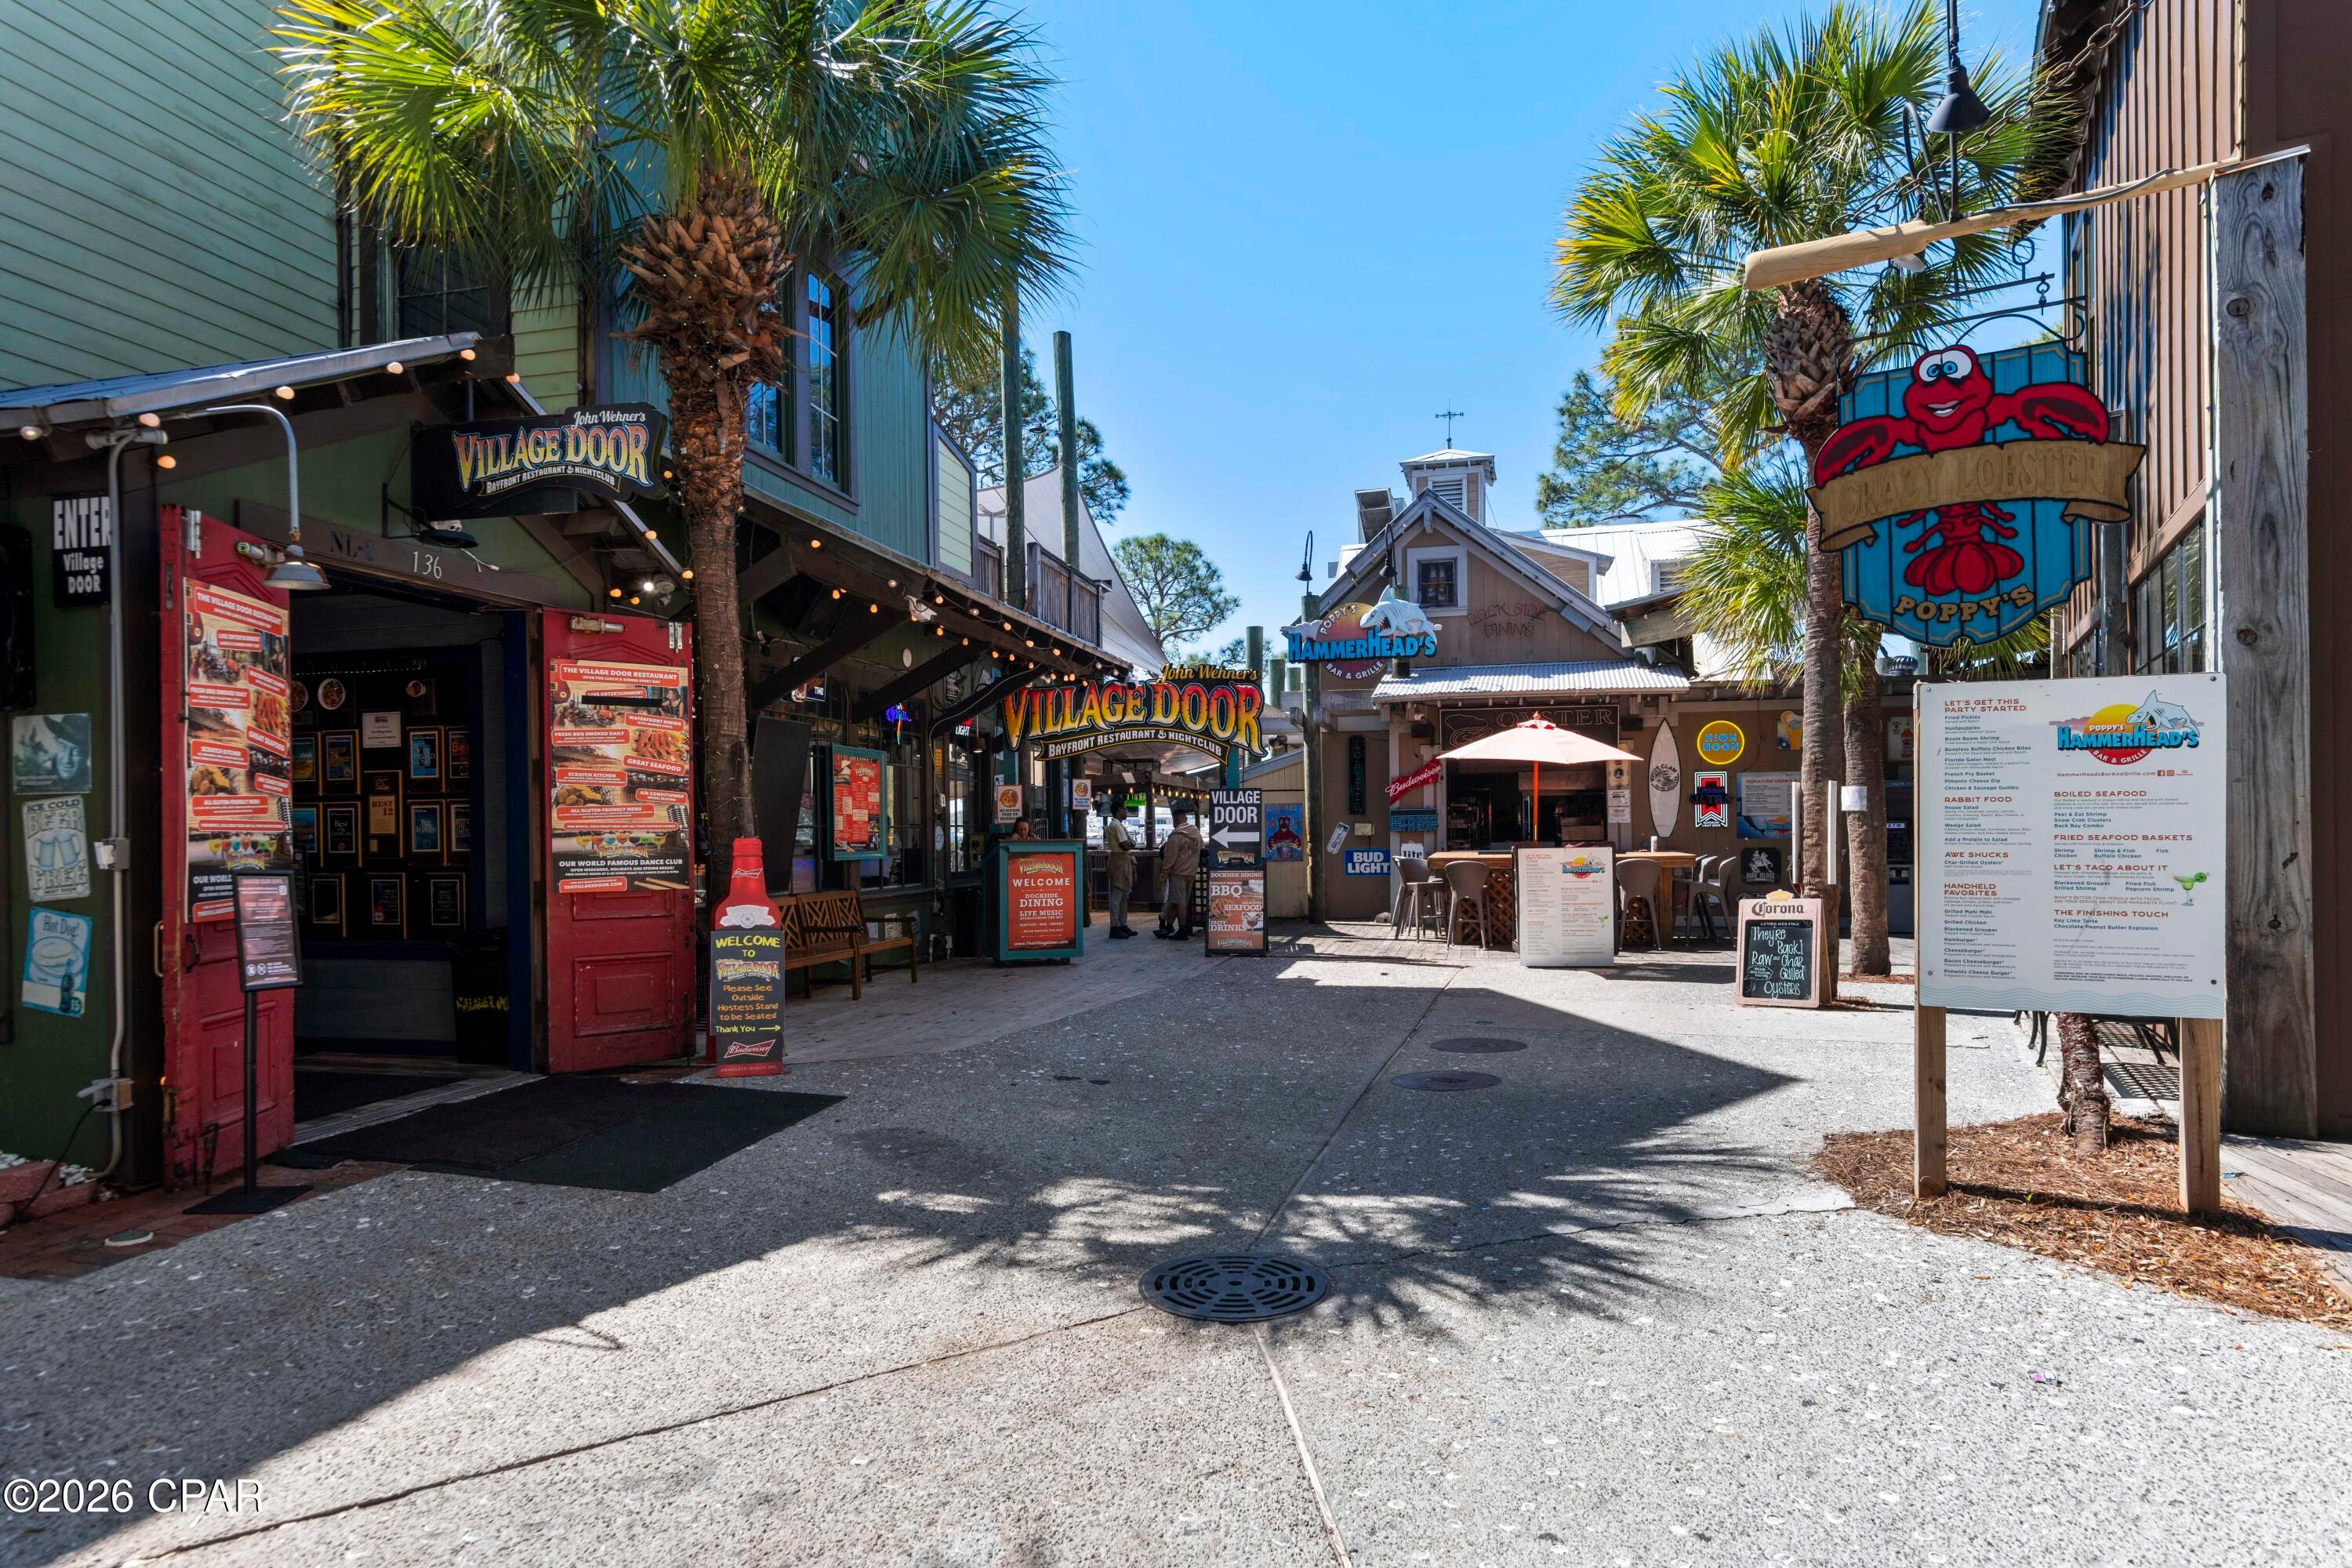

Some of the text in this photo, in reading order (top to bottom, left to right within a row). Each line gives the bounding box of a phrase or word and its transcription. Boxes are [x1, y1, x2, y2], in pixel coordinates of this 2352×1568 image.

[571, 410, 646, 430] John Wehner's
[452, 423, 654, 492] VILLAGE DOOR
[486, 465, 615, 494] BAYFRONT RESTAURANT & NIGHTCLUB
[1840, 448, 2105, 522] CRAZY LOBSTER
[54, 496, 111, 550] ENTER
[64, 553, 103, 574] Village
[413, 551, 442, 579] 136
[68, 575, 101, 593] DOOR
[1895, 585, 2034, 623] POPPY'S
[1320, 604, 1357, 634] POPPY'S
[1467, 603, 1507, 626] DOCK
[1288, 628, 1436, 662] HAMMERHEAD'S
[1156, 664, 1258, 684] John Wehner's
[1326, 662, 1341, 677] BAR
[1355, 660, 1384, 679] GRILLE
[629, 715, 663, 724] WATERFRONT
[1002, 681, 1147, 750] VILLAGE
[1147, 681, 1268, 757] DOOR
[956, 725, 971, 736] LIGHT
[2058, 726, 2200, 750] HAMMERHEAD'S
[1048, 728, 1221, 757] BAYFRONT RESTAURANT & NIGHTCLUB
[627, 758, 681, 772] GREAT SEAFOOD
[2092, 750, 2108, 761] BAR
[2121, 750, 2147, 764] GRILLE
[1385, 764, 1441, 797] Budweiser
[1650, 764, 1677, 782] WHITE CLAW
[649, 790, 684, 799] CONDITIONED
[1211, 791, 1261, 804] VILLAGE
[27, 799, 80, 812] ICE COLD
[27, 808, 83, 839] BEER
[1214, 807, 1258, 823] DOOR
[1353, 852, 1384, 862] BUD
[31, 862, 87, 889] FREE
[1348, 863, 1389, 873] LIGHT
[1013, 878, 1070, 887] WELCOME
[1211, 885, 1243, 898] BBQ
[1019, 898, 1063, 907] DINING
[1751, 902, 1804, 917] Corona
[716, 935, 781, 949] WELCOME
[1777, 940, 1803, 954] Back!
[1751, 951, 1773, 965] Raw
[716, 961, 780, 980] VILLAGE DOOR
[728, 1045, 769, 1054] Budweiser
